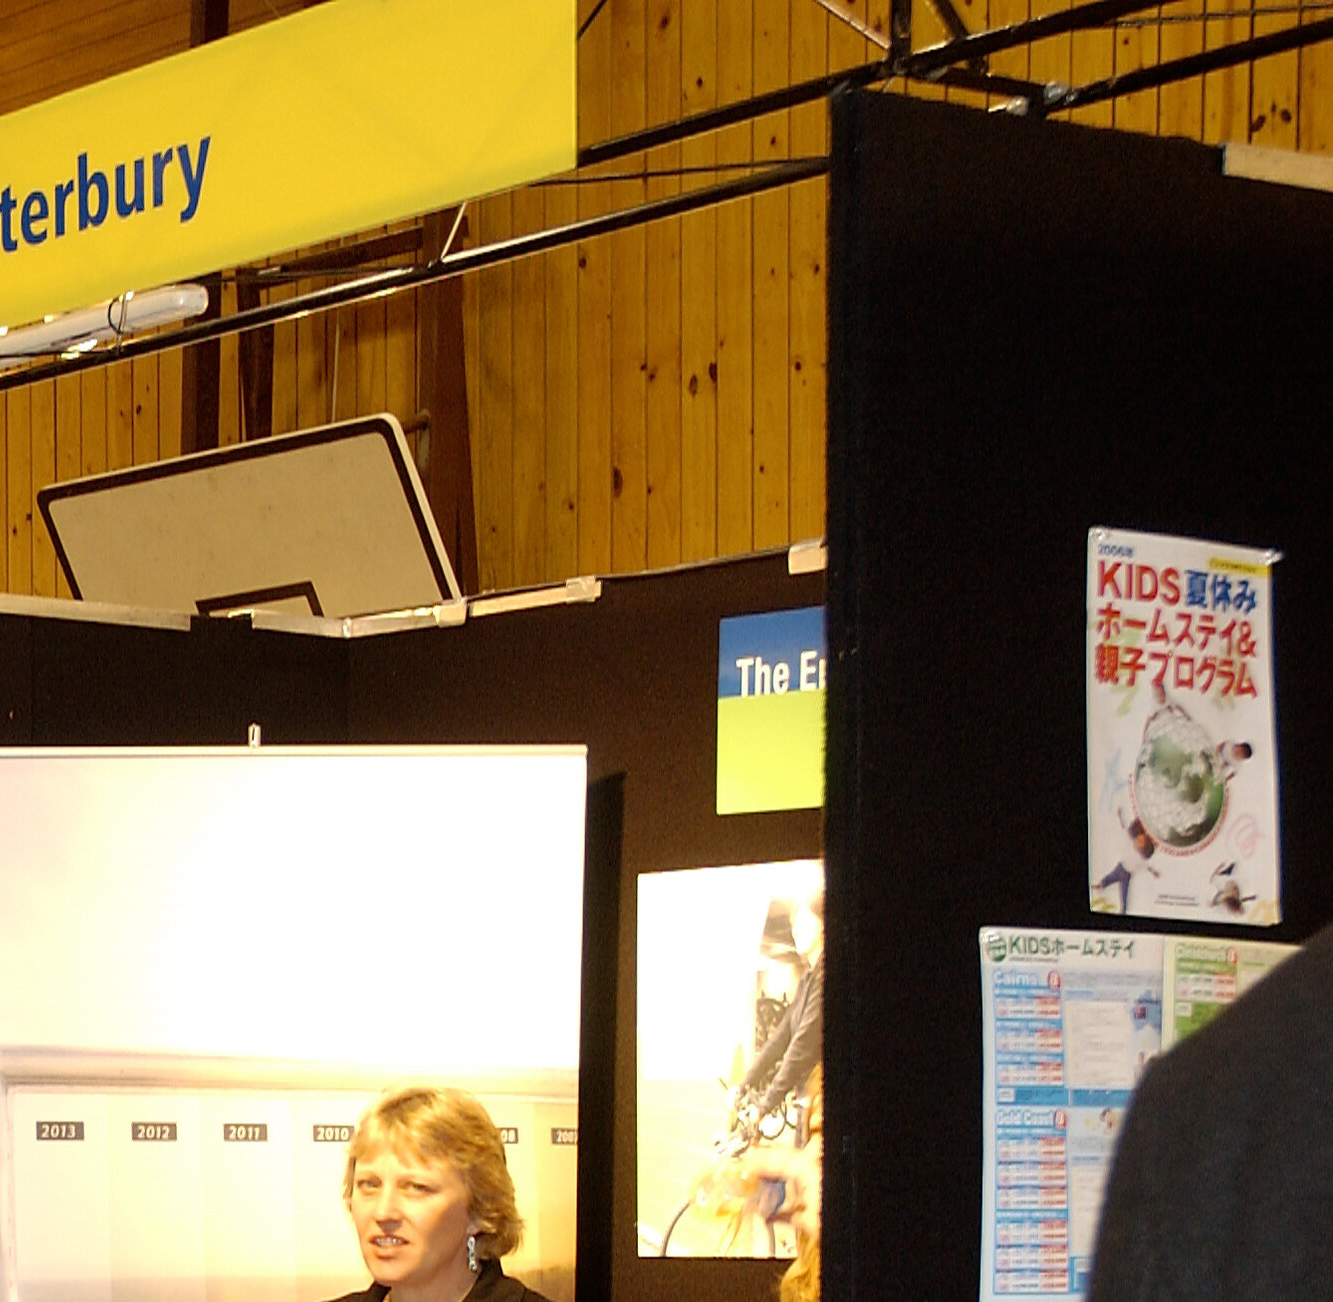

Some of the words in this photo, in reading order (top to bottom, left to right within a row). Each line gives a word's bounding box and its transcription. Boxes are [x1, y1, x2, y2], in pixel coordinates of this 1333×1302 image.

[736, 656, 789, 697] The
[1095, 643, 1258, 699] 親子プログラム
[1008, 935, 1136, 959] KIDSホームステイ
[40, 1124, 76, 1139] 2013
[137, 1125, 170, 1139] 2012
[228, 1126, 261, 1140] 2011
[316, 1127, 349, 1141] 2010
